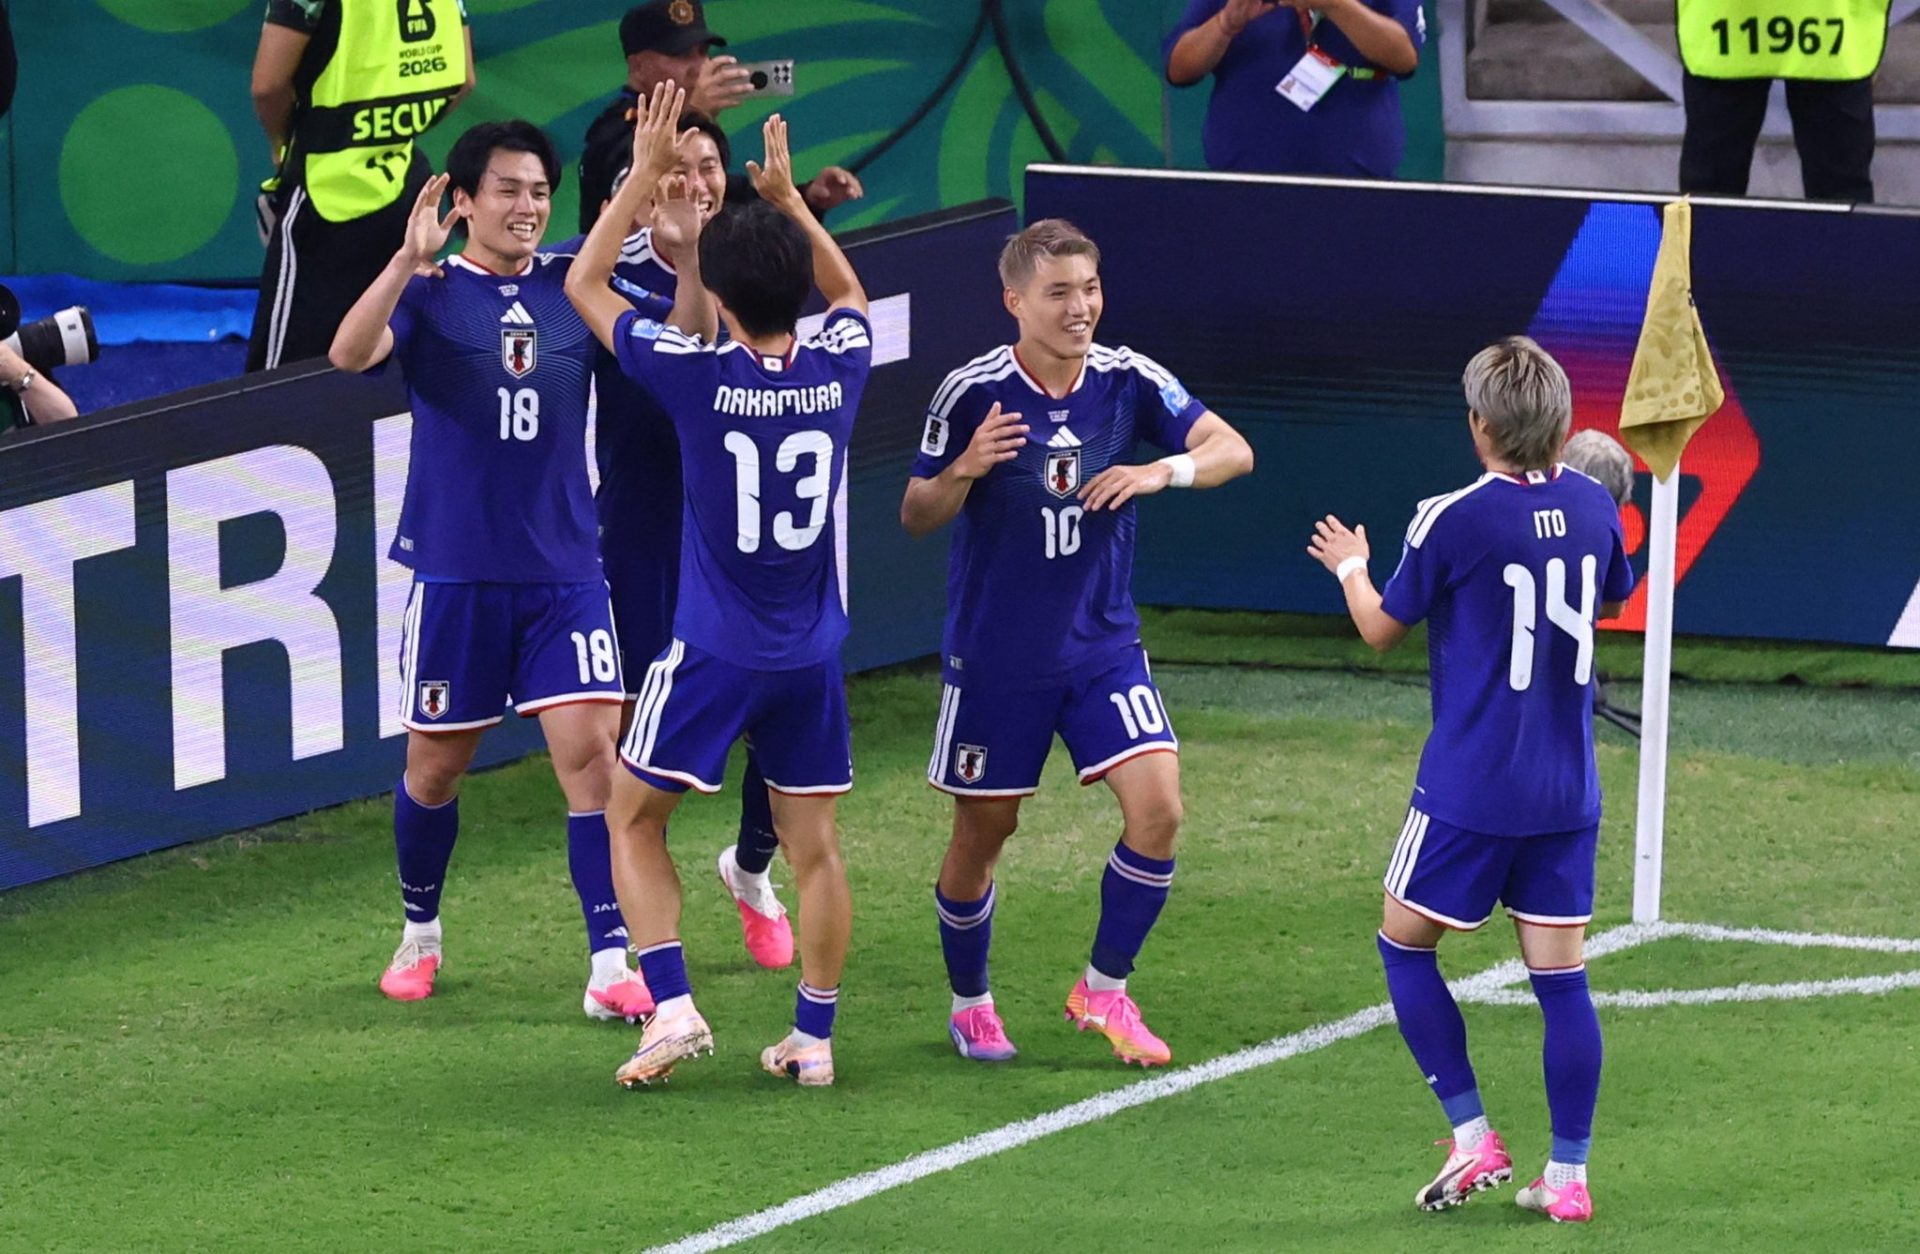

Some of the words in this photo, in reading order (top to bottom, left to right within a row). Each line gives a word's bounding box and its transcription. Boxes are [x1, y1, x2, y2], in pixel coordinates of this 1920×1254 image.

[399, 47, 425, 59] WORLD
[426, 44, 442, 56] CUP
[1712, 16, 1844, 56] 11967
[399, 57, 447, 78] 2026
[497, 387, 539, 441] 18
[713, 381, 842, 417] NAKAMURA
[724, 430, 833, 553] 13
[1041, 505, 1084, 559] 10
[1533, 509, 1567, 539] ITO
[1503, 554, 1597, 691] 14
[571, 629, 615, 684] 18
[1109, 685, 1164, 740] 10
